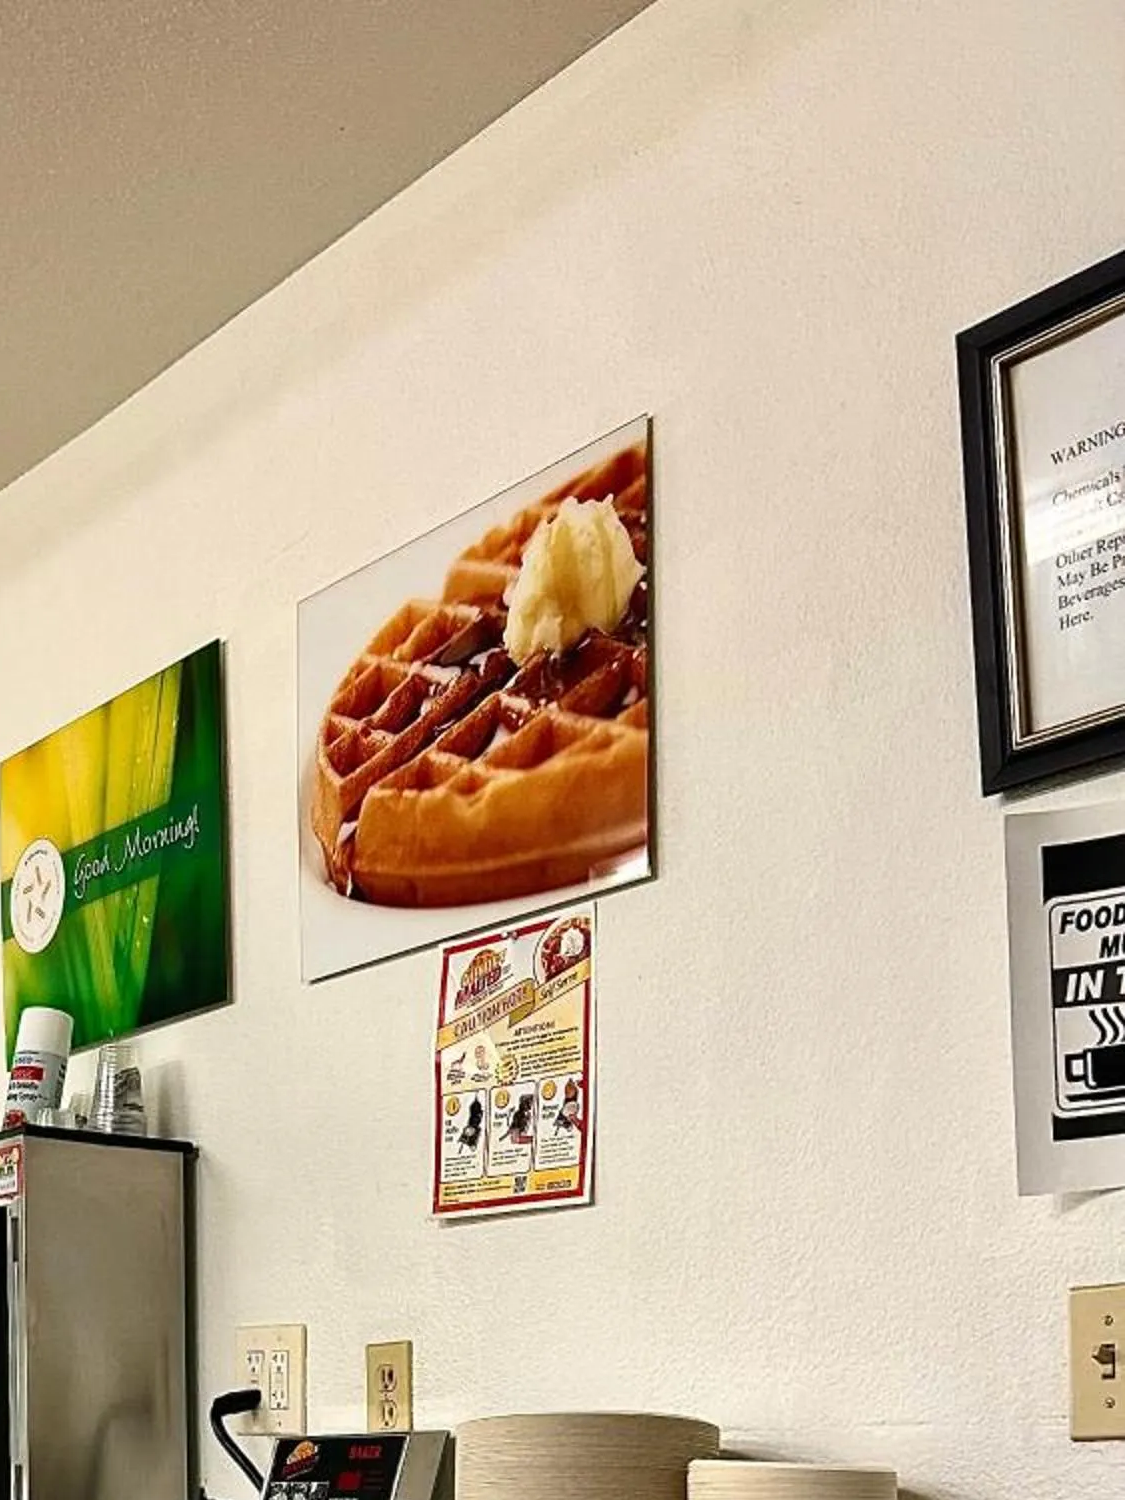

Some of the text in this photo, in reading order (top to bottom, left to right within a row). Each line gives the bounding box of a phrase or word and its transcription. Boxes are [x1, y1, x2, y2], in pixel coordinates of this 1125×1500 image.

[1050, 421, 1125, 465] WARNING
[1055, 547, 1093, 569] Other
[1057, 571, 1086, 590] May
[1090, 561, 1109, 577] Be
[1058, 611, 1094, 631] Here.
[74, 804, 200, 899] Good Morning!
[1065, 969, 1104, 1003] IN
